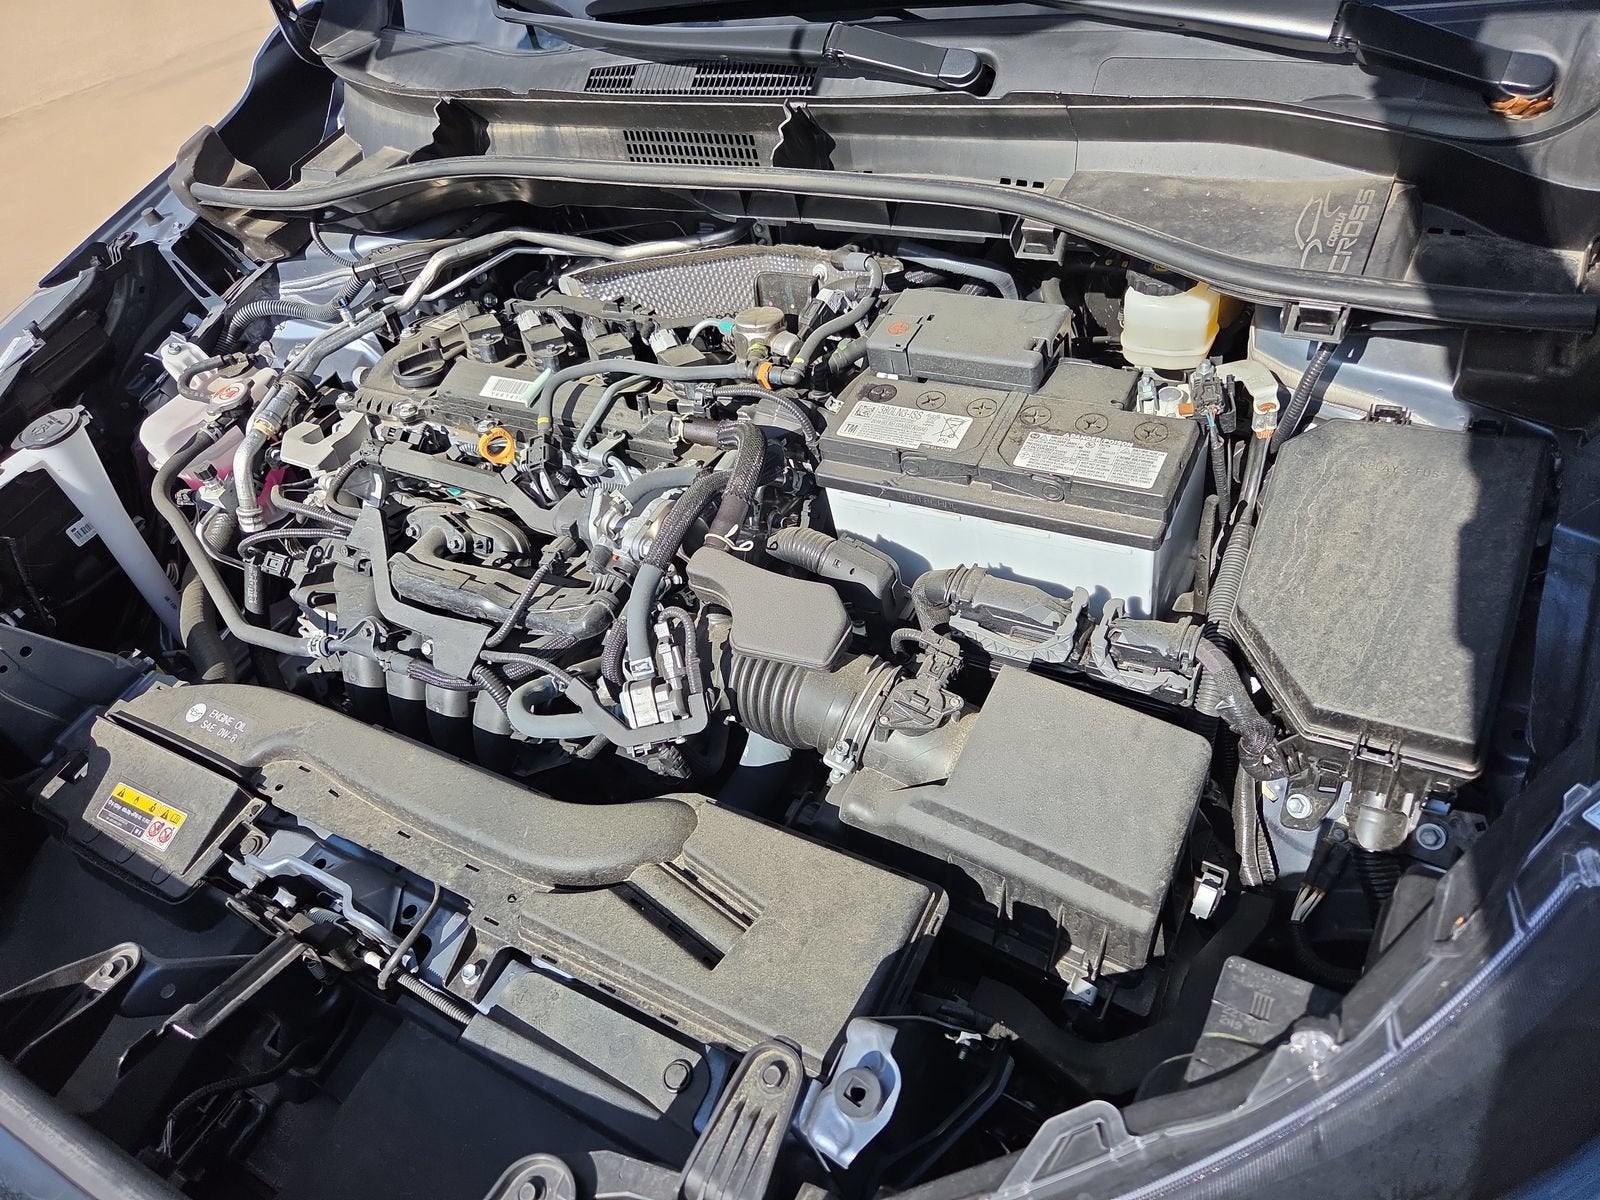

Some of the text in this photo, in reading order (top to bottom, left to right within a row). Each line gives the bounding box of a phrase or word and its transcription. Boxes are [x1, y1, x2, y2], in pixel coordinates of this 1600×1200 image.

[1327, 213, 1348, 247] COROLLA
[1327, 189, 1376, 273] CROSS
[843, 423, 859, 433] TM
[200, 720, 217, 733] SAE
[209, 709, 247, 733] ENGINE OIL
